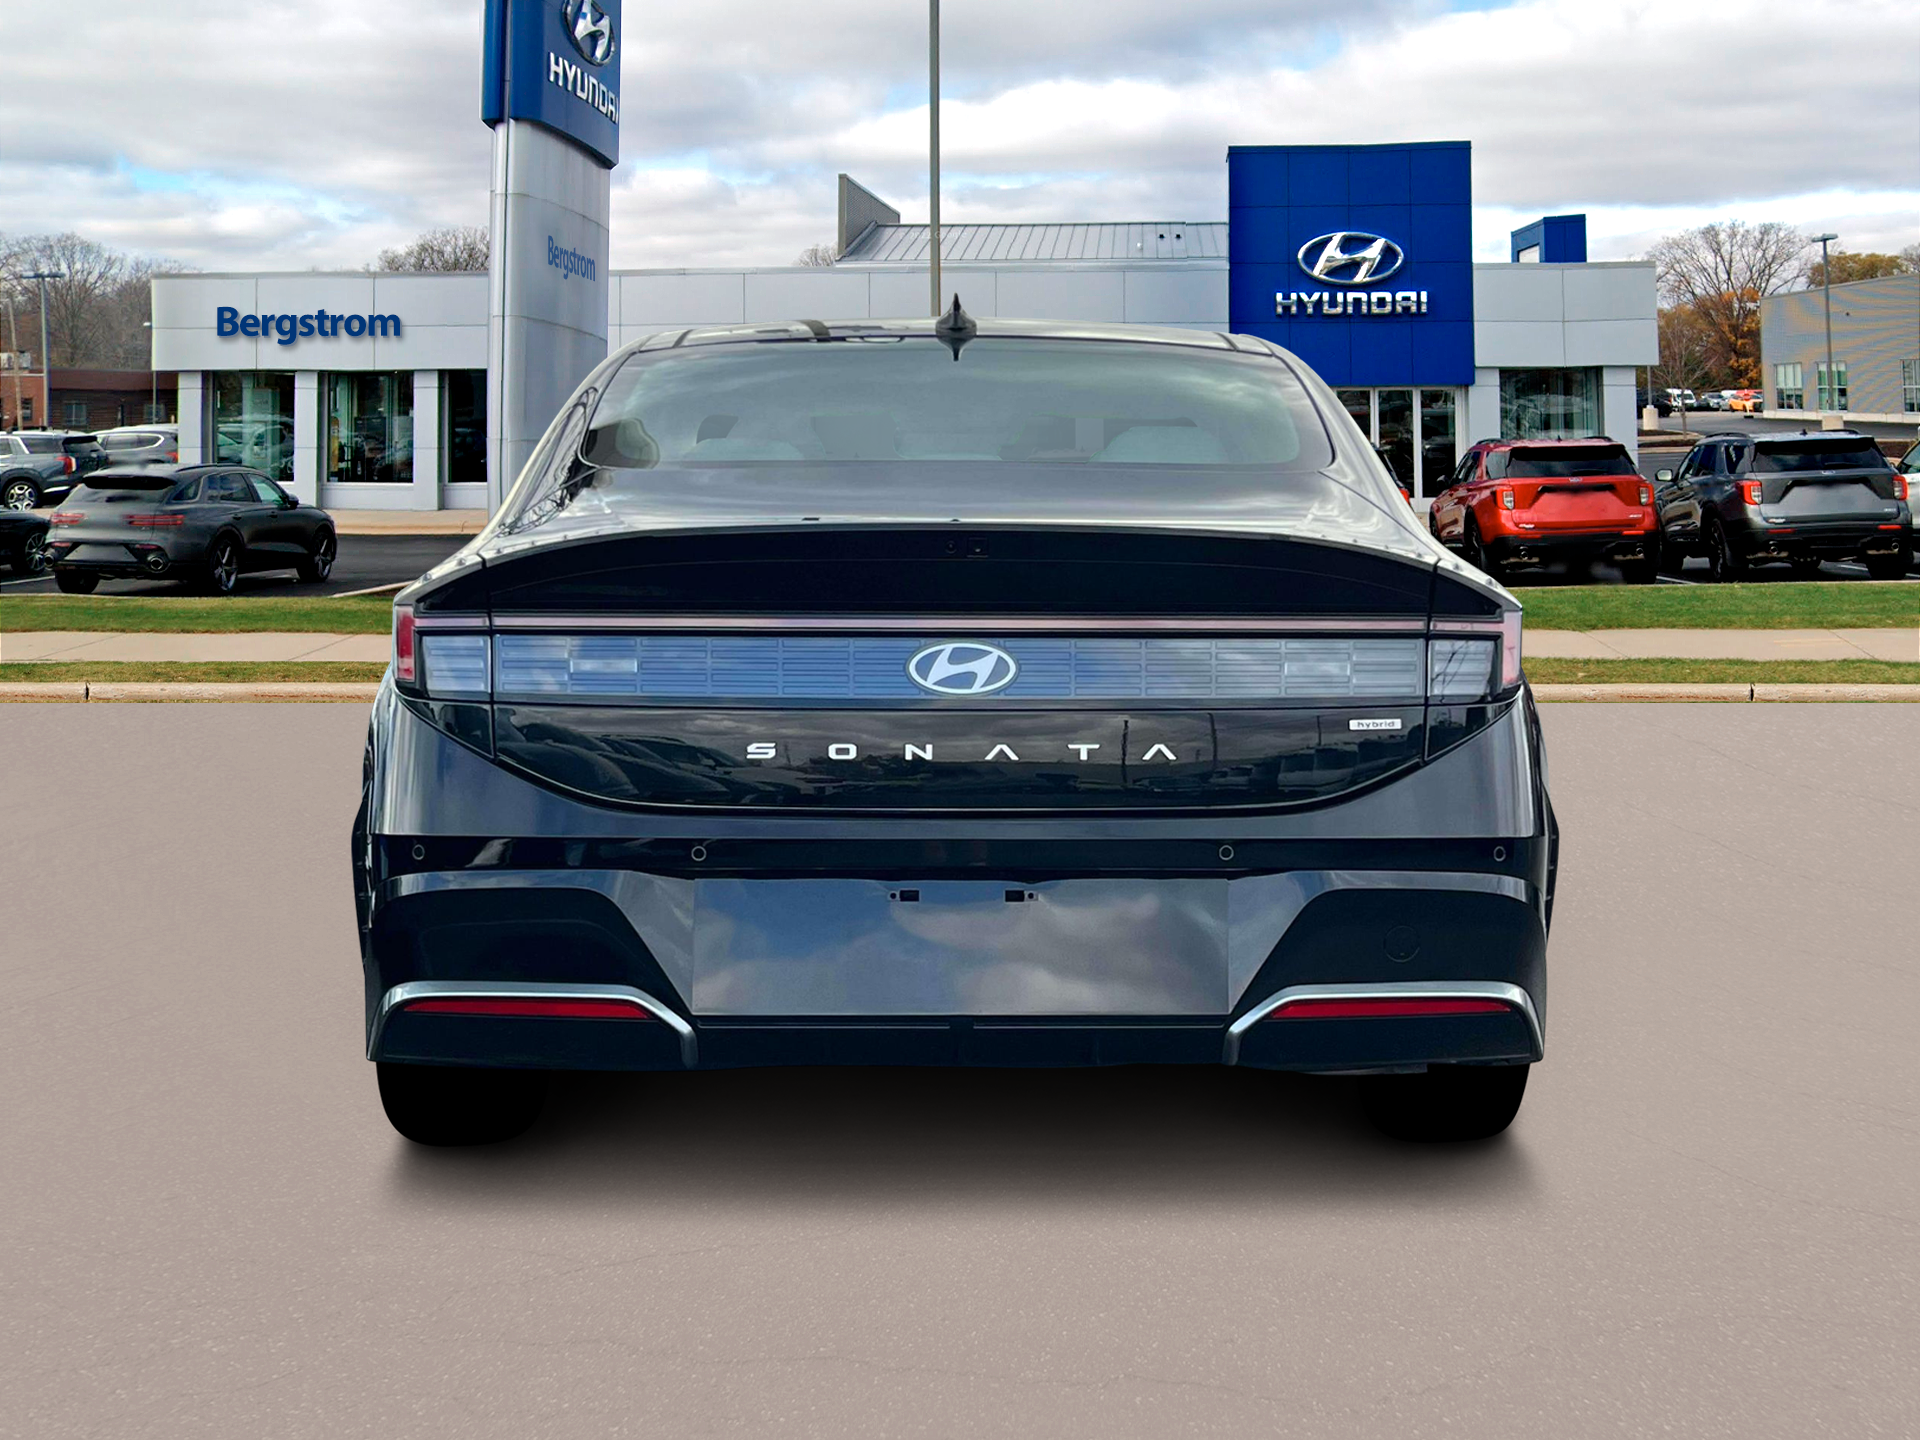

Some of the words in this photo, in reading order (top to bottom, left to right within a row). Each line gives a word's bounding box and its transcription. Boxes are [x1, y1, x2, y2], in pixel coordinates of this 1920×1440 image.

[549, 52, 619, 124] HYUNDAI
[547, 234, 596, 282] Bergstrom
[1275, 291, 1428, 316] HYUNDAI
[216, 306, 401, 346] Bergstrom
[1357, 720, 1396, 728] hybrid
[746, 742, 1178, 761] SONATA
